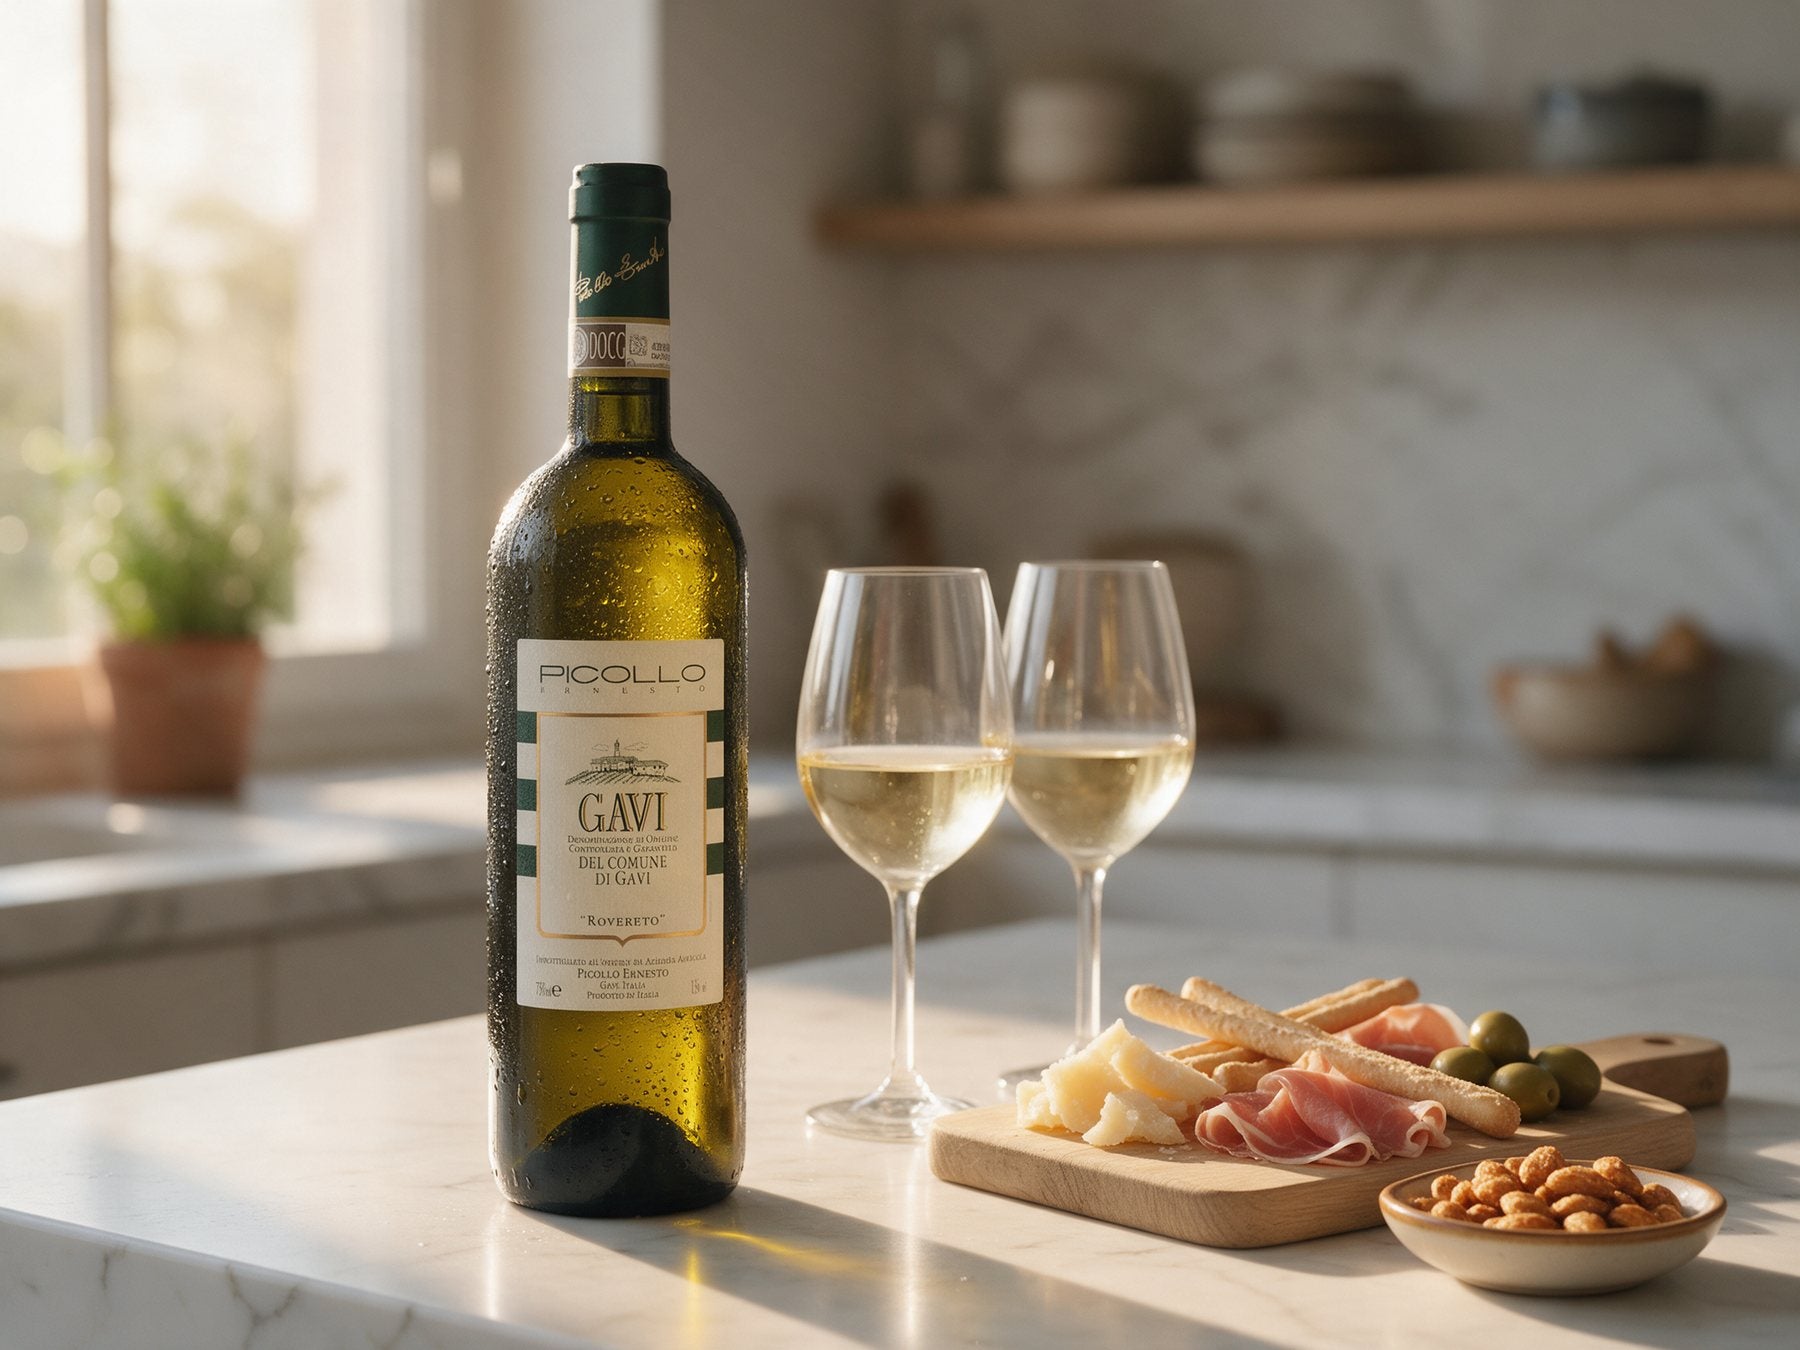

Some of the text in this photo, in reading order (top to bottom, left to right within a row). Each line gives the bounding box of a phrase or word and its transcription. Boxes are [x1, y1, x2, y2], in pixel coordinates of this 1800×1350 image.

[539, 664, 706, 684] PICOLLO
[540, 685, 706, 695] ERNESTO
[578, 791, 669, 833] GAVI
[578, 855, 668, 869] DEL COMUNE
[595, 872, 610, 886] DI
